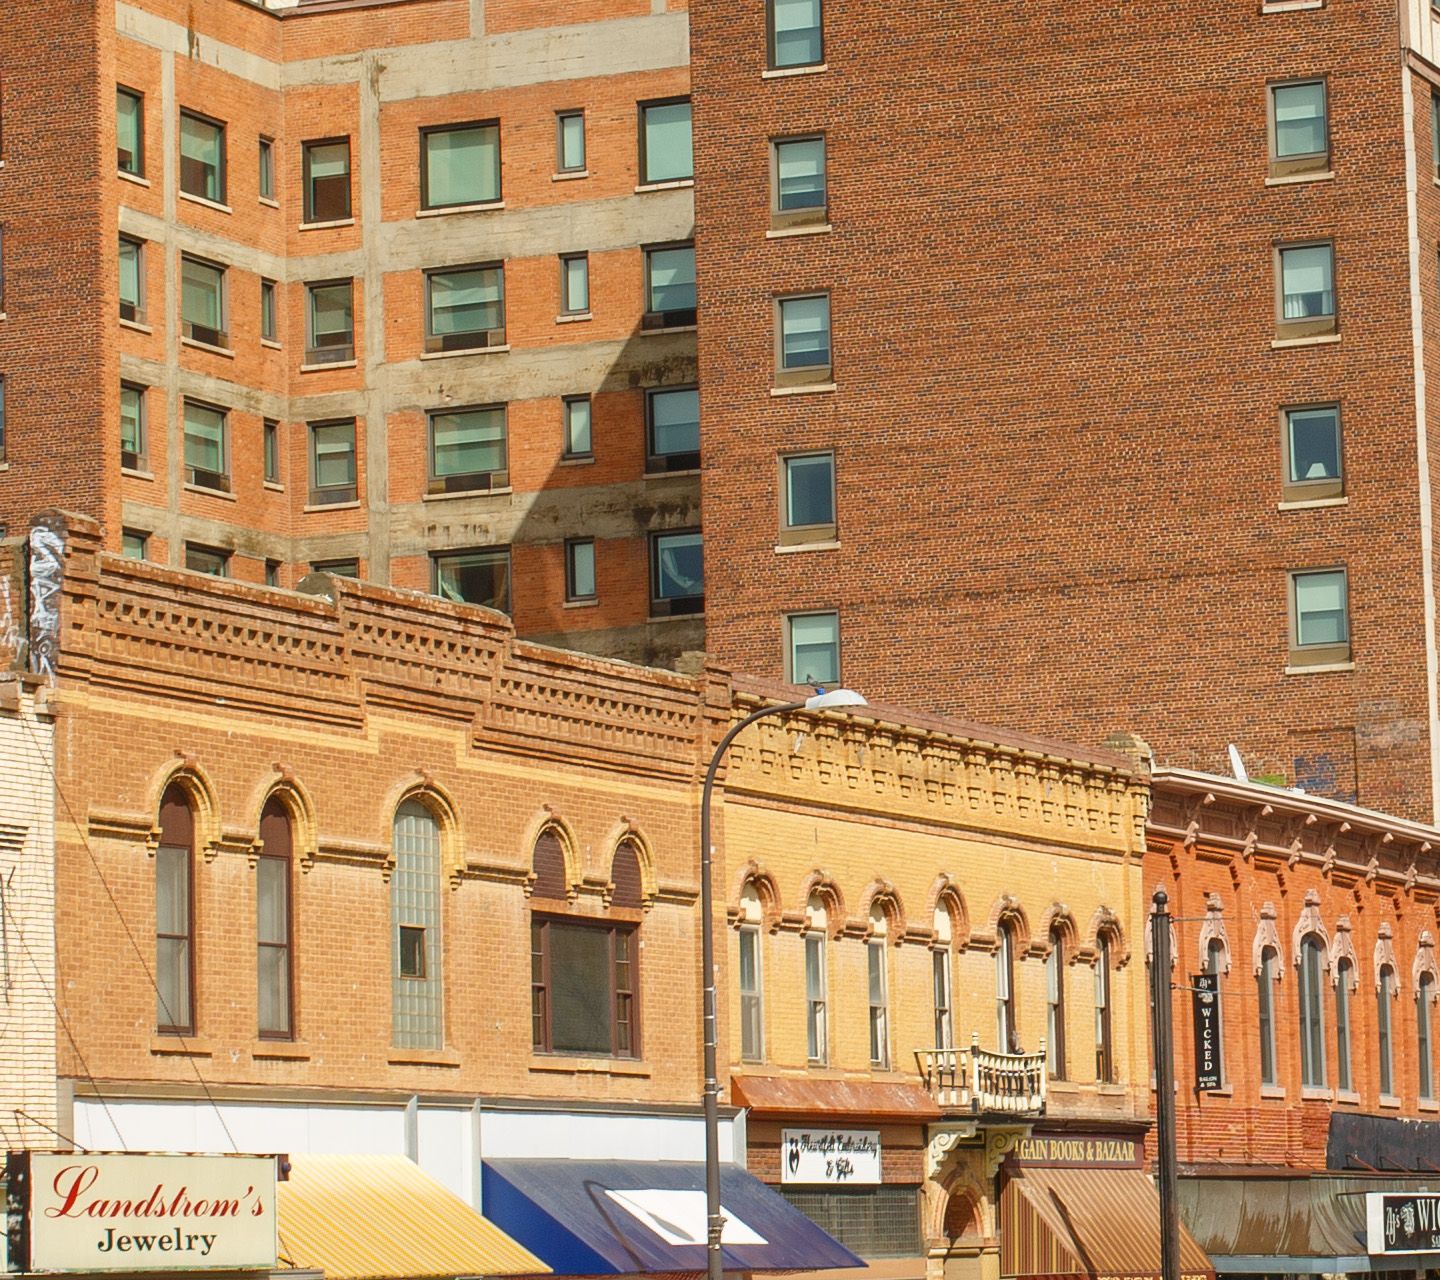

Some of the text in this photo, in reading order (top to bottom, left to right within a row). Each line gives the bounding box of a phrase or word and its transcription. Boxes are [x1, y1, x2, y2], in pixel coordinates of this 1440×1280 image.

[1201, 1007, 1213, 1071] WICKED
[1050, 1140, 1084, 1160] BOOKS
[1086, 1141, 1094, 1160] &
[1095, 1141, 1136, 1161] BAZAAR
[44, 1165, 265, 1219] Landstrom's
[98, 1227, 216, 1255] Jewelry
